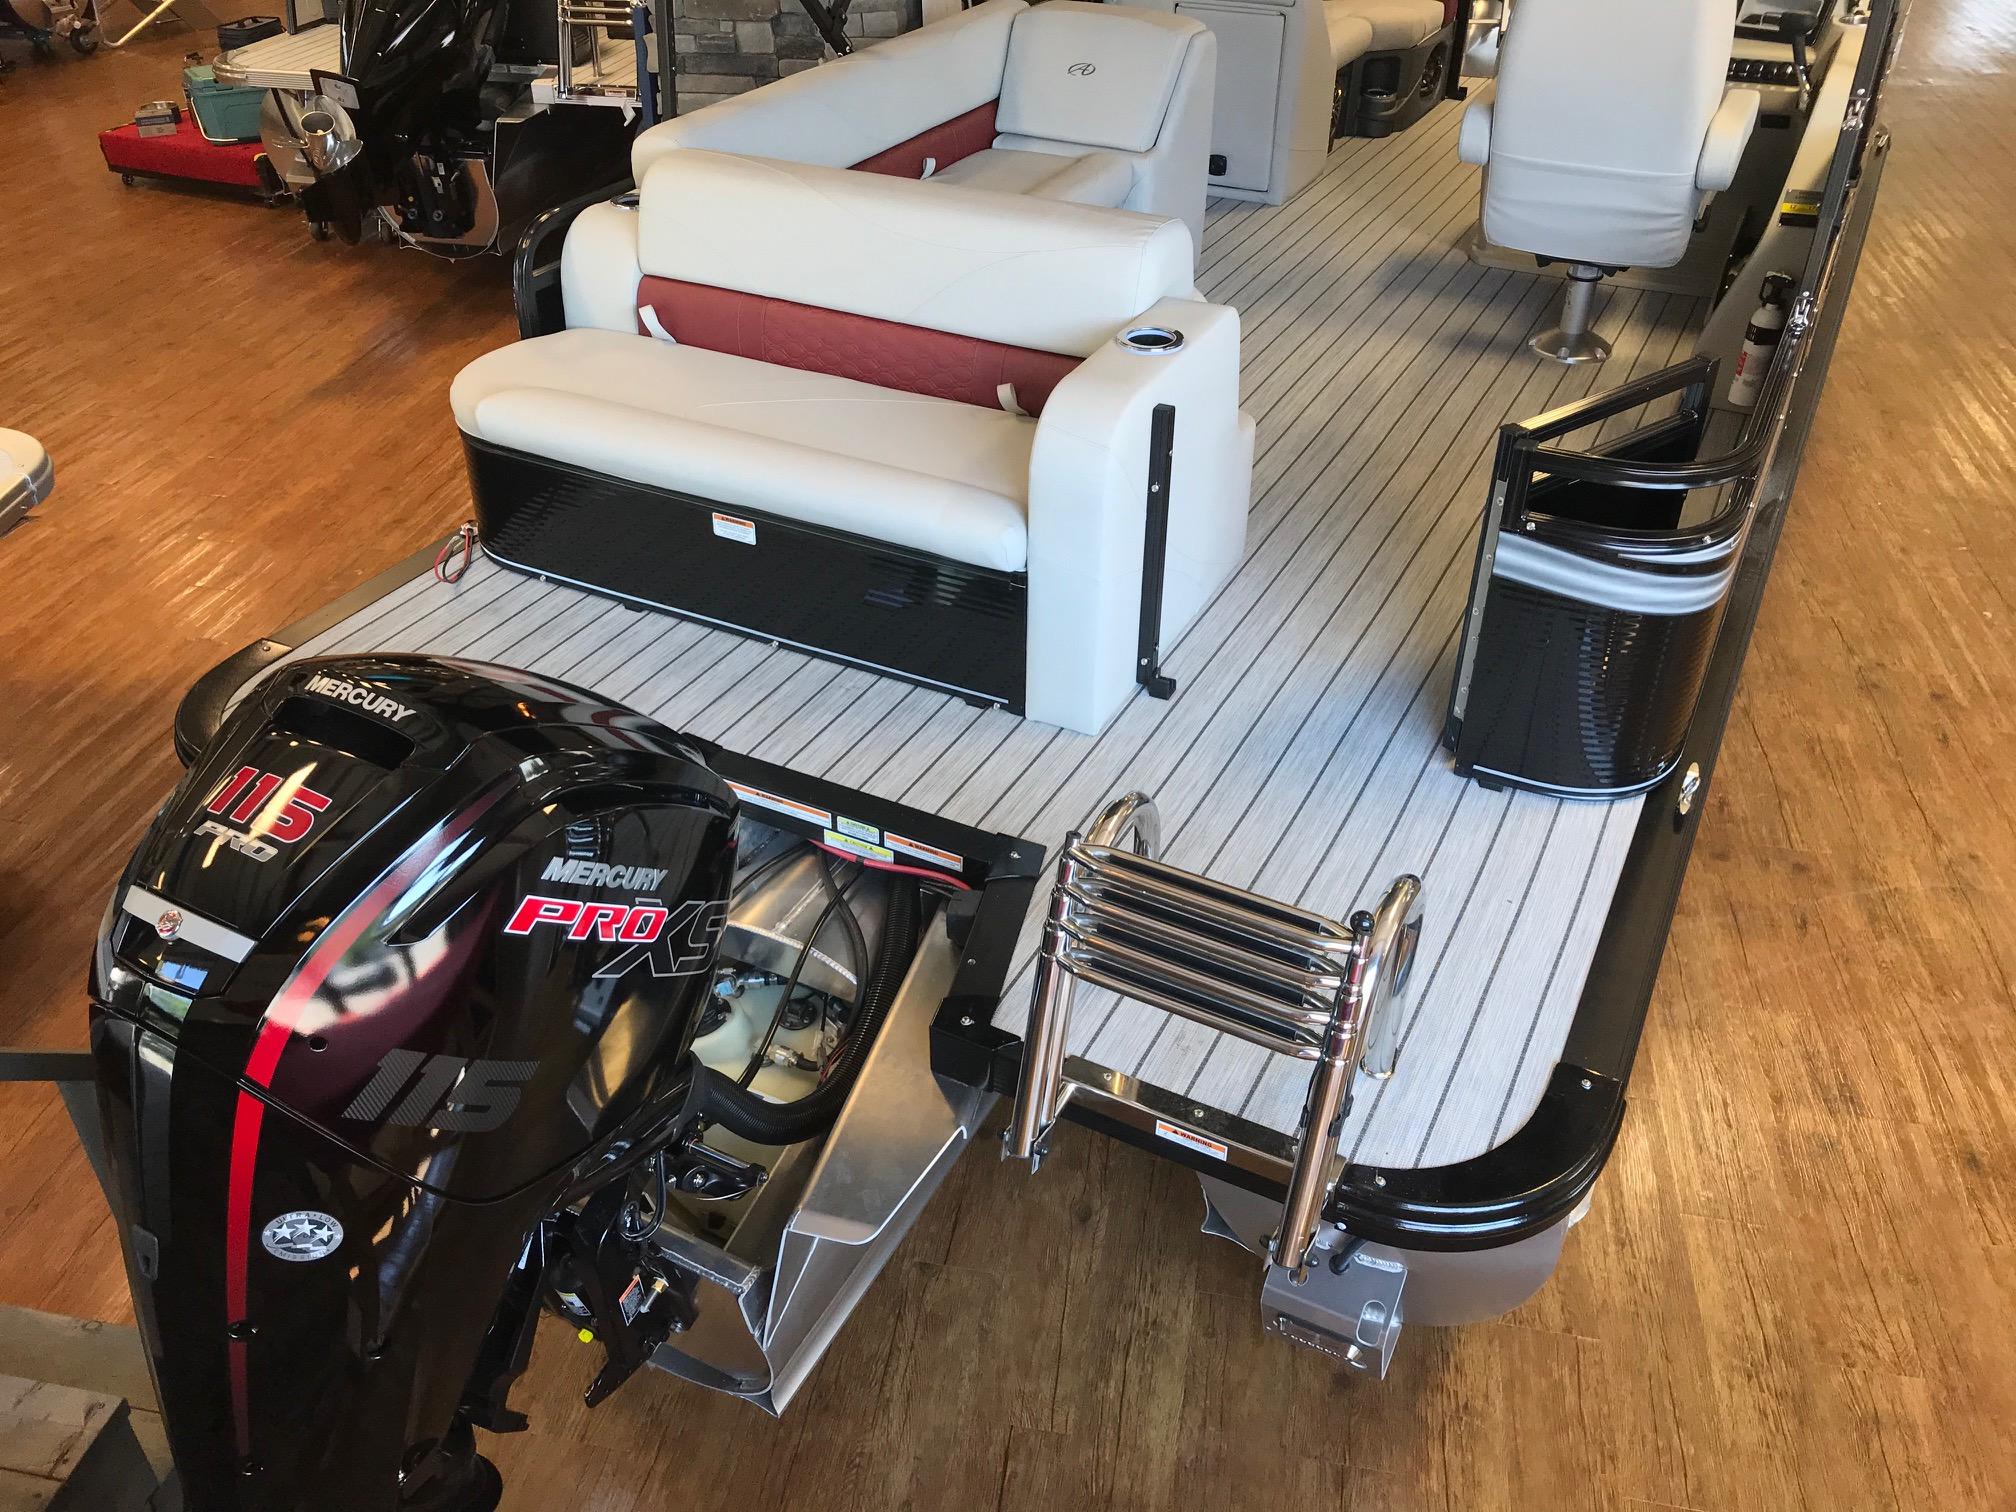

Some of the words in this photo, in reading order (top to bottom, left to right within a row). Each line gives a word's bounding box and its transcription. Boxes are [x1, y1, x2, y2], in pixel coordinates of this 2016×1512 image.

[304, 674, 417, 723] MERCURY
[206, 765, 333, 843] 115
[193, 819, 279, 863] PRO
[540, 855, 669, 892] MERCURY
[503, 894, 669, 943] PRO
[341, 1048, 541, 1132] 115
[1180, 1131, 1213, 1148] WARNING
